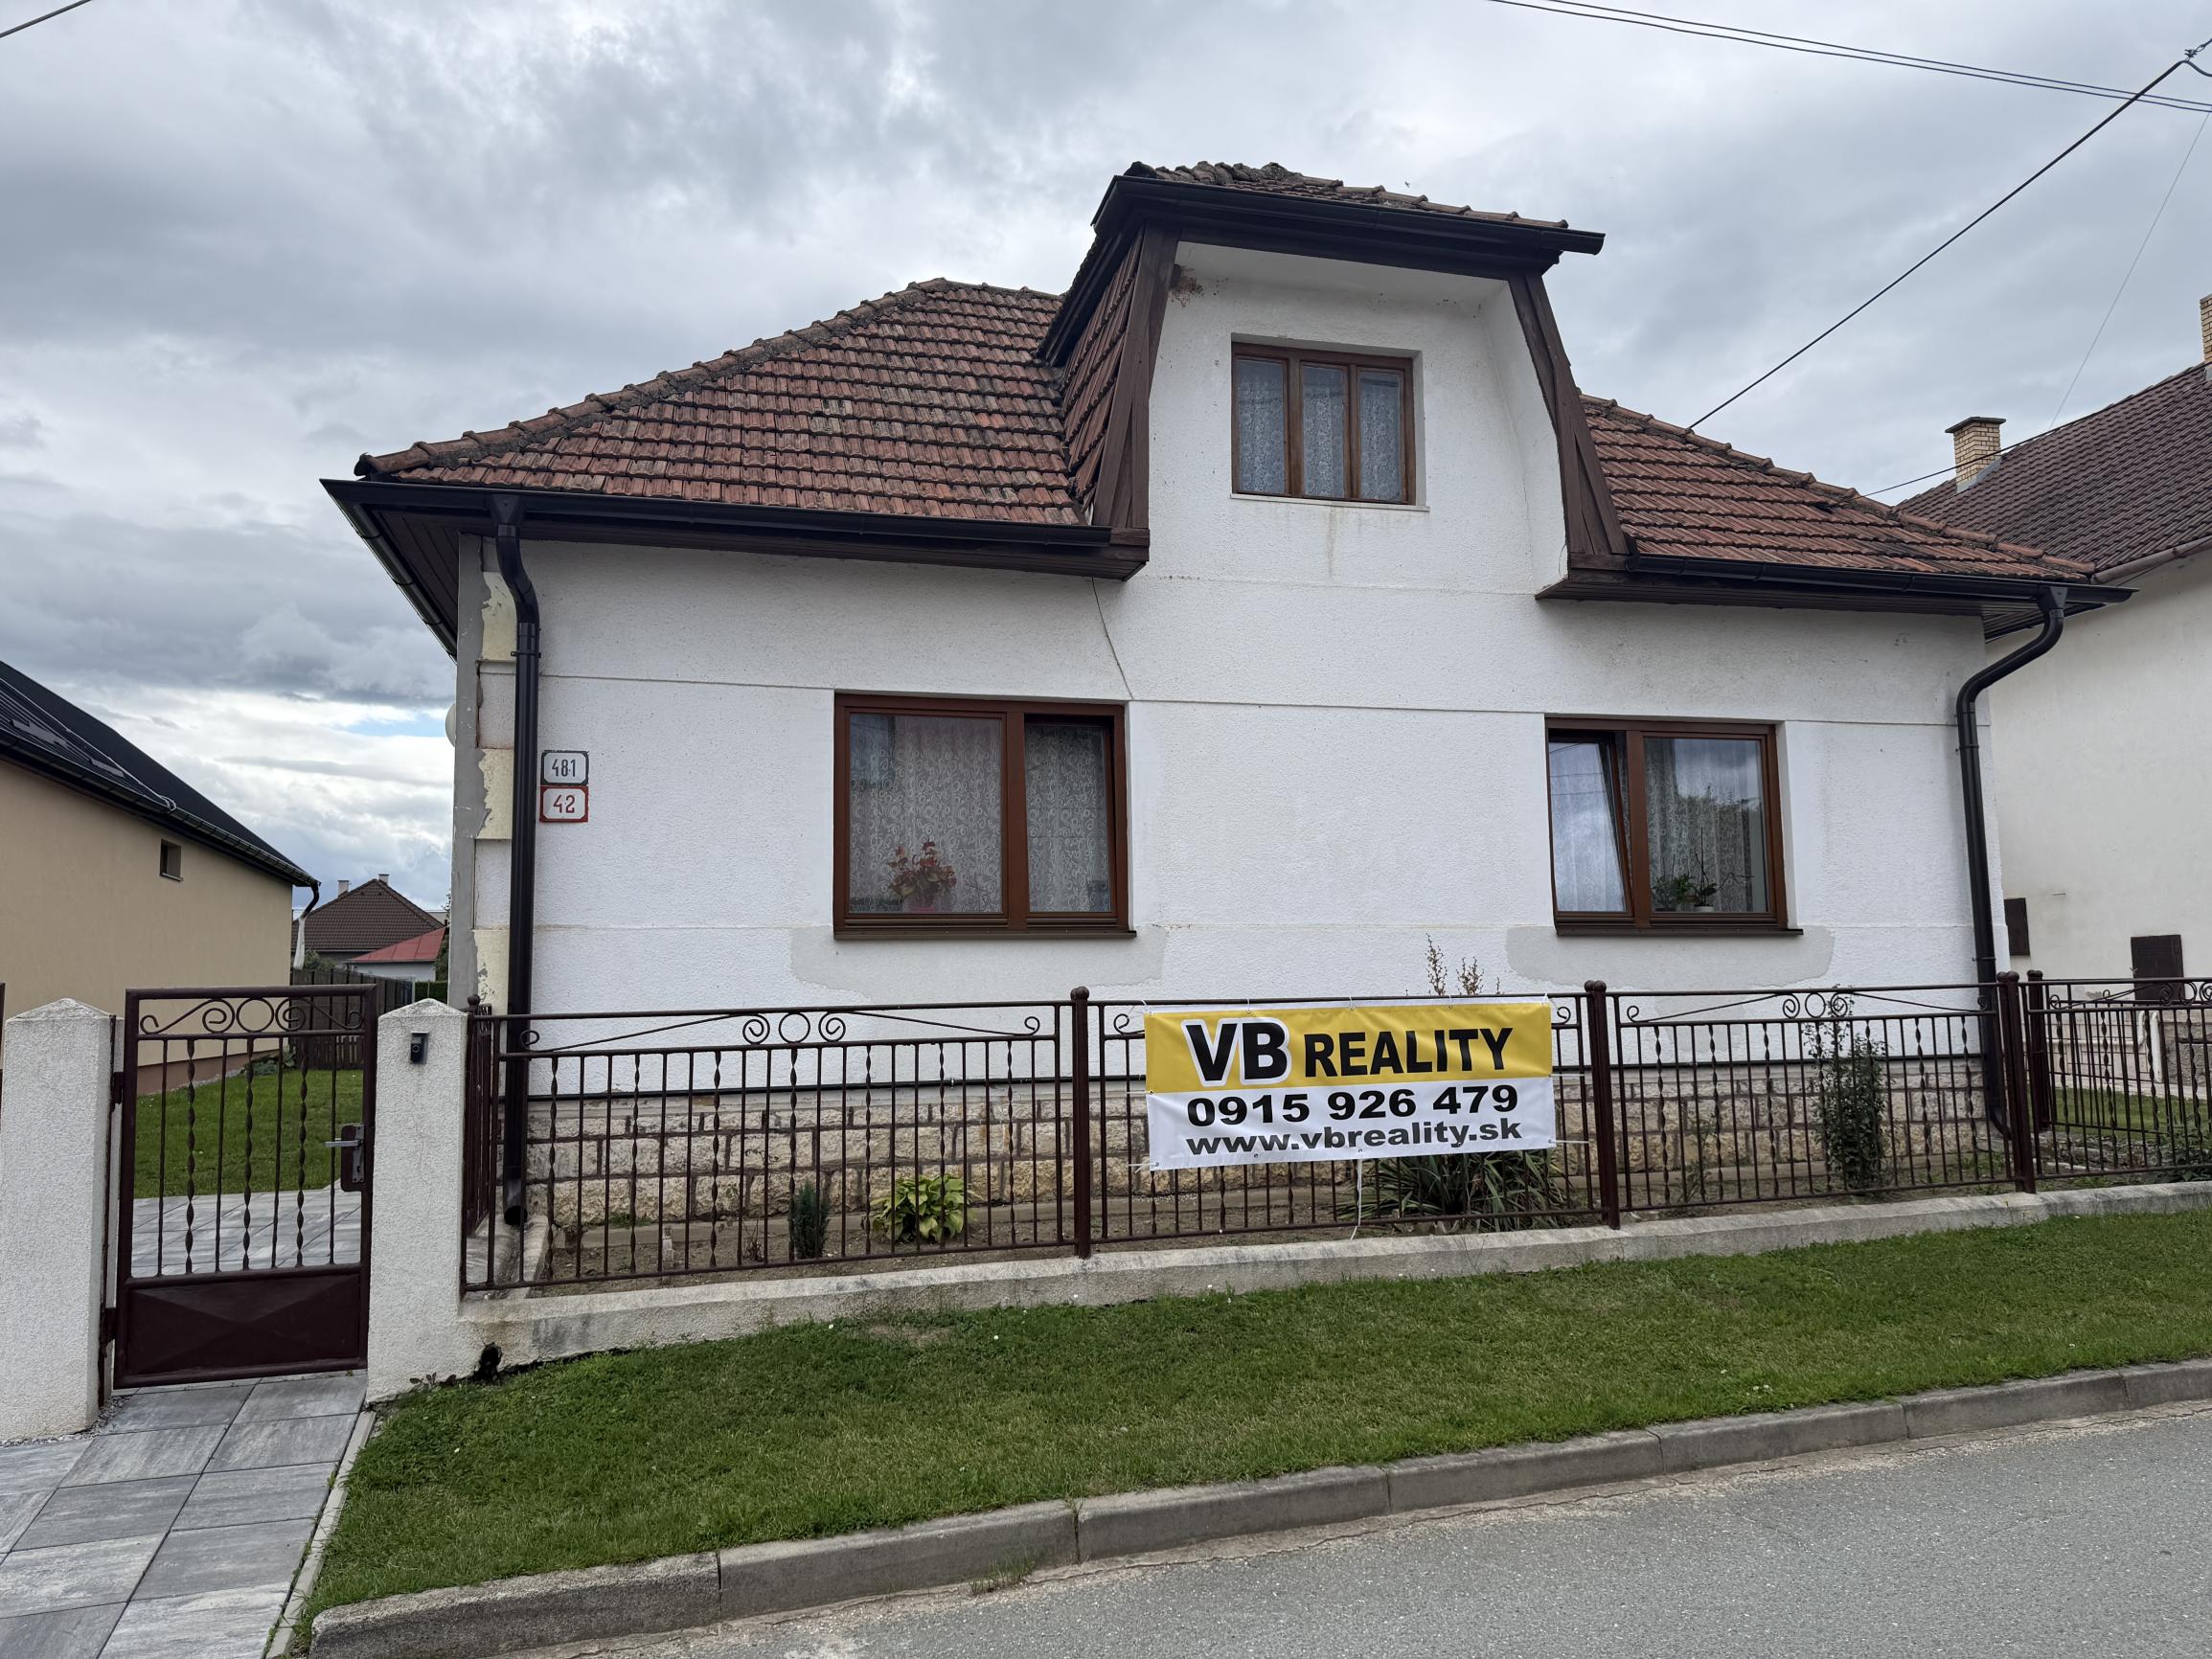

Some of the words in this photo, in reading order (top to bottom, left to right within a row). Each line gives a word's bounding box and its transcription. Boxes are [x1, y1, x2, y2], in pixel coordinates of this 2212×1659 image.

[552, 759, 576, 777] 481
[553, 794, 575, 813] 42
[1184, 1020, 1288, 1083] VB
[1304, 1028, 1514, 1078] REALITY
[1187, 1093, 1311, 1127] 0915
[1328, 1088, 1417, 1121] 926
[1432, 1084, 1518, 1114] 479
[1186, 1118, 1523, 1155] www.vbreality.sk
